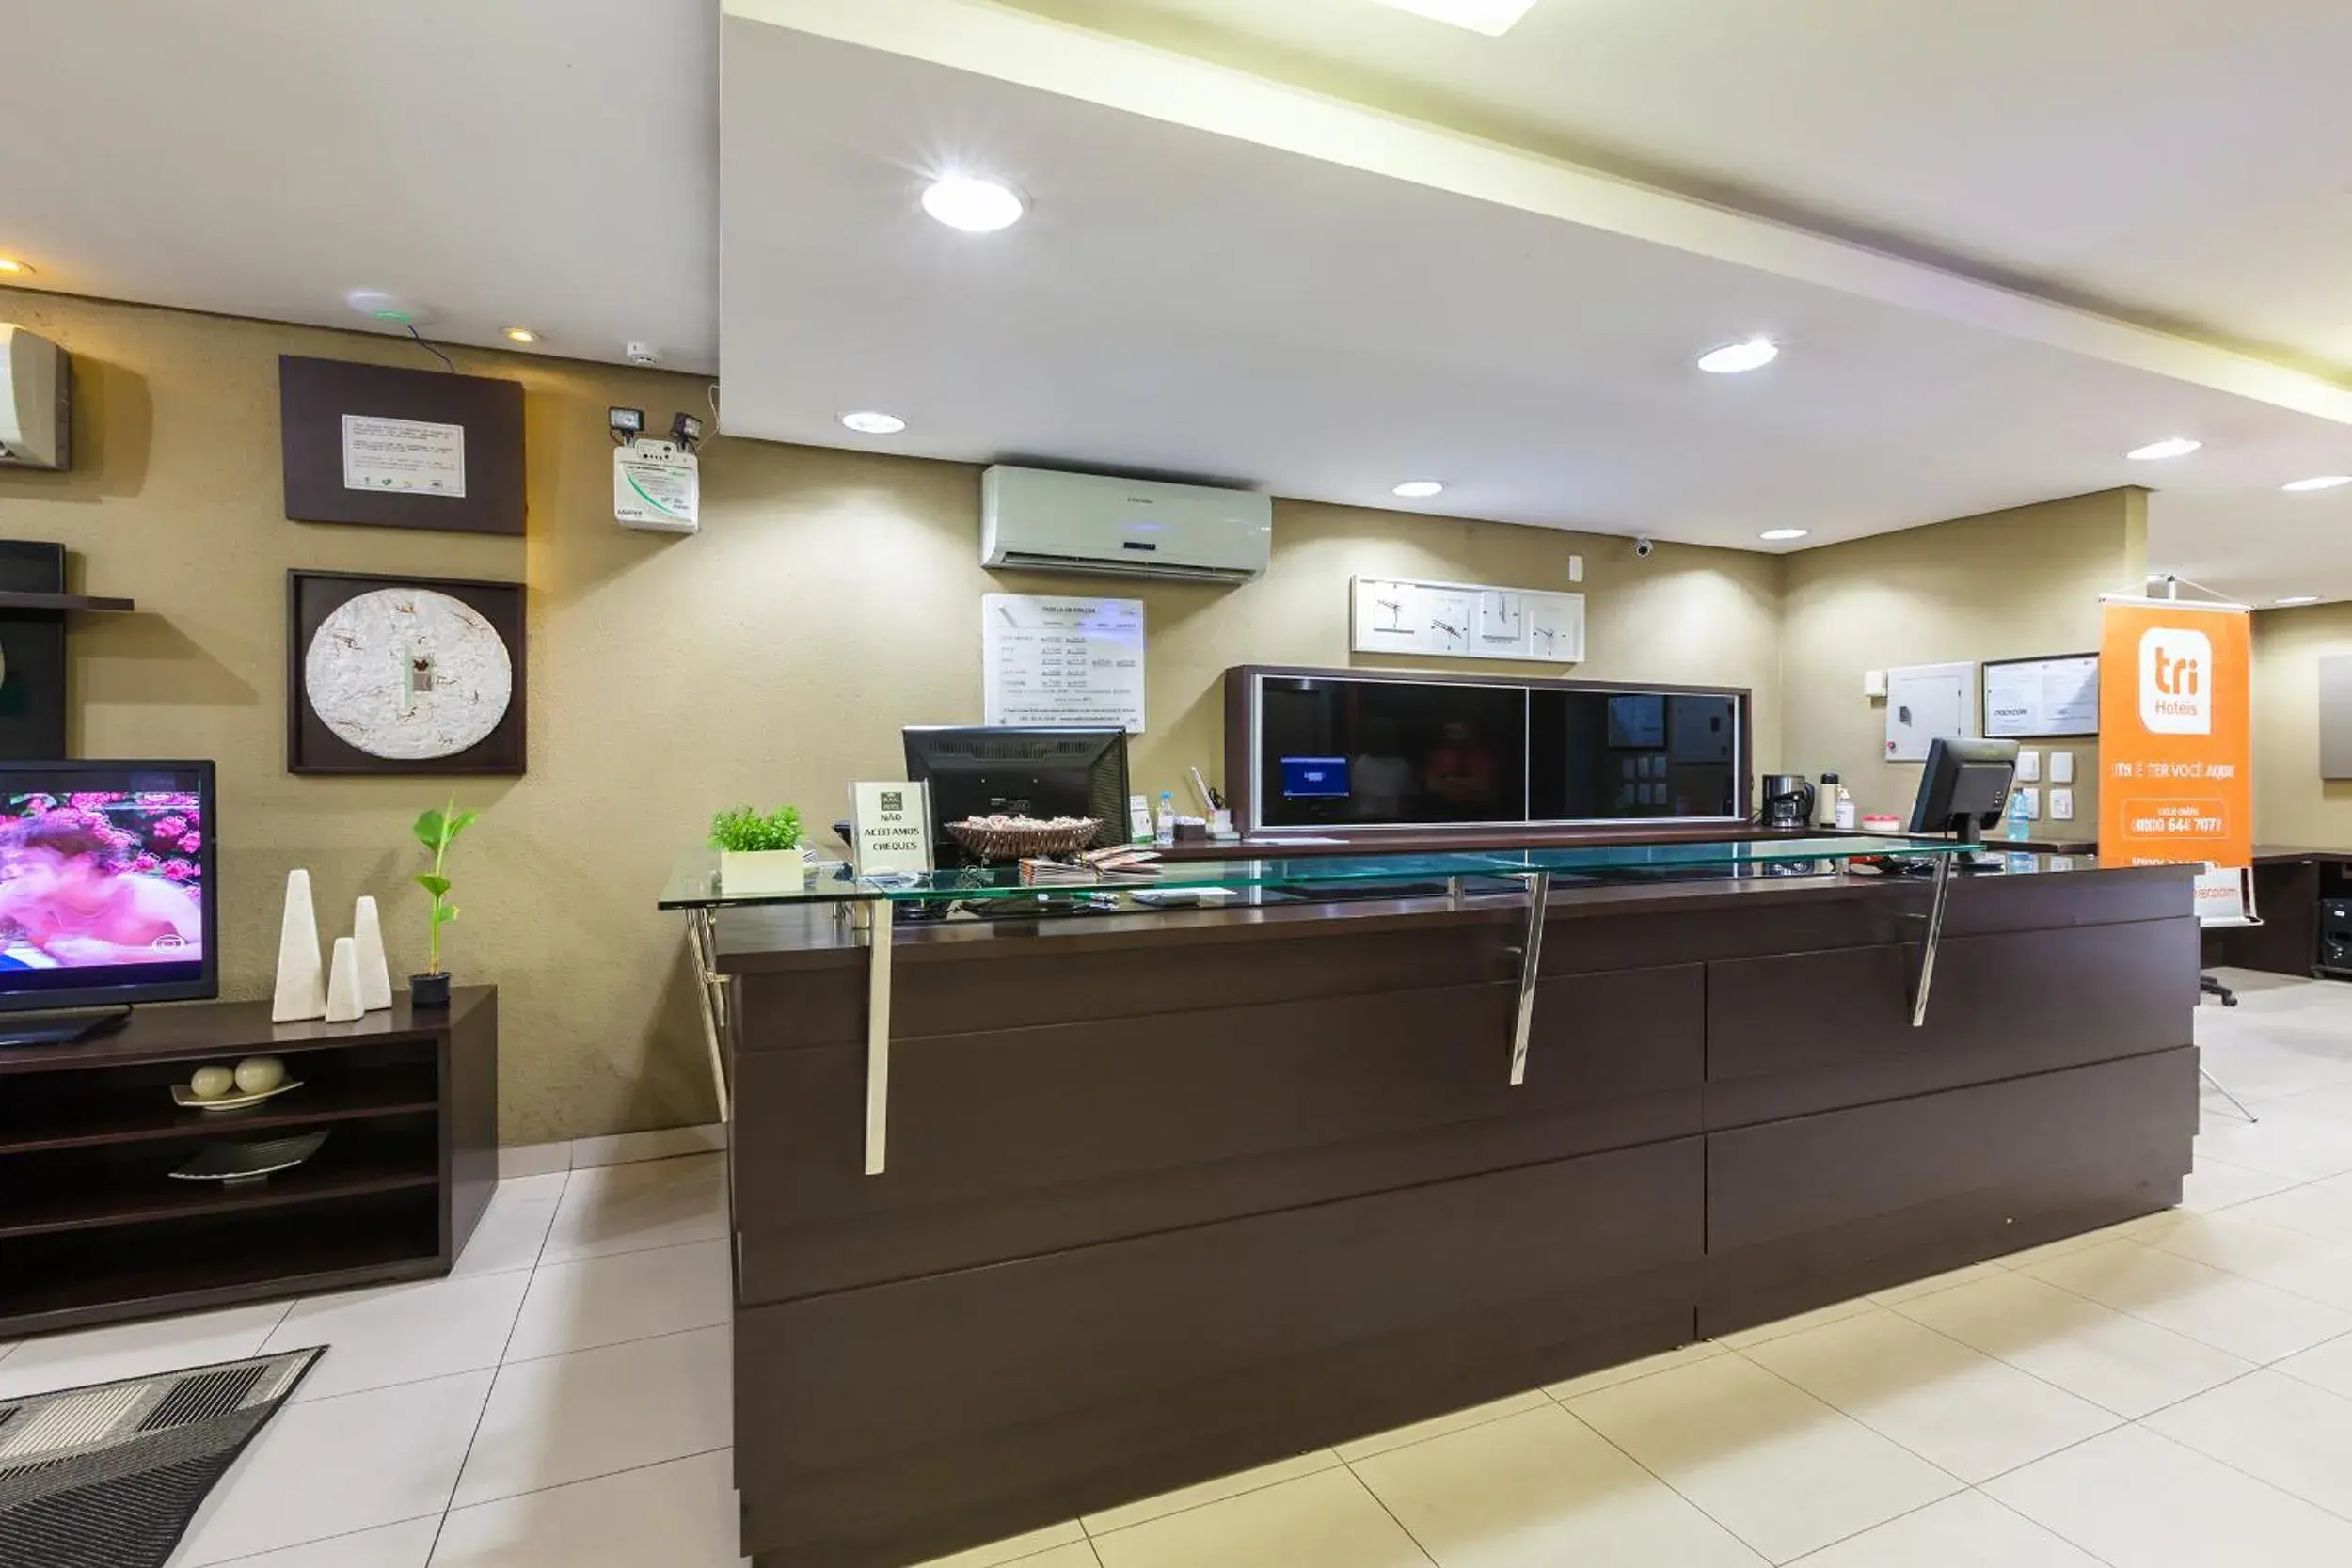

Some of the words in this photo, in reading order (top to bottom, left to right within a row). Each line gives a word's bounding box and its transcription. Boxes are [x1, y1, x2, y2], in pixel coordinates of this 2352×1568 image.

[2155, 646, 2198, 695] tri
[864, 827, 919, 835] ACEITAMOS
[872, 841, 917, 850] CHEQUES
